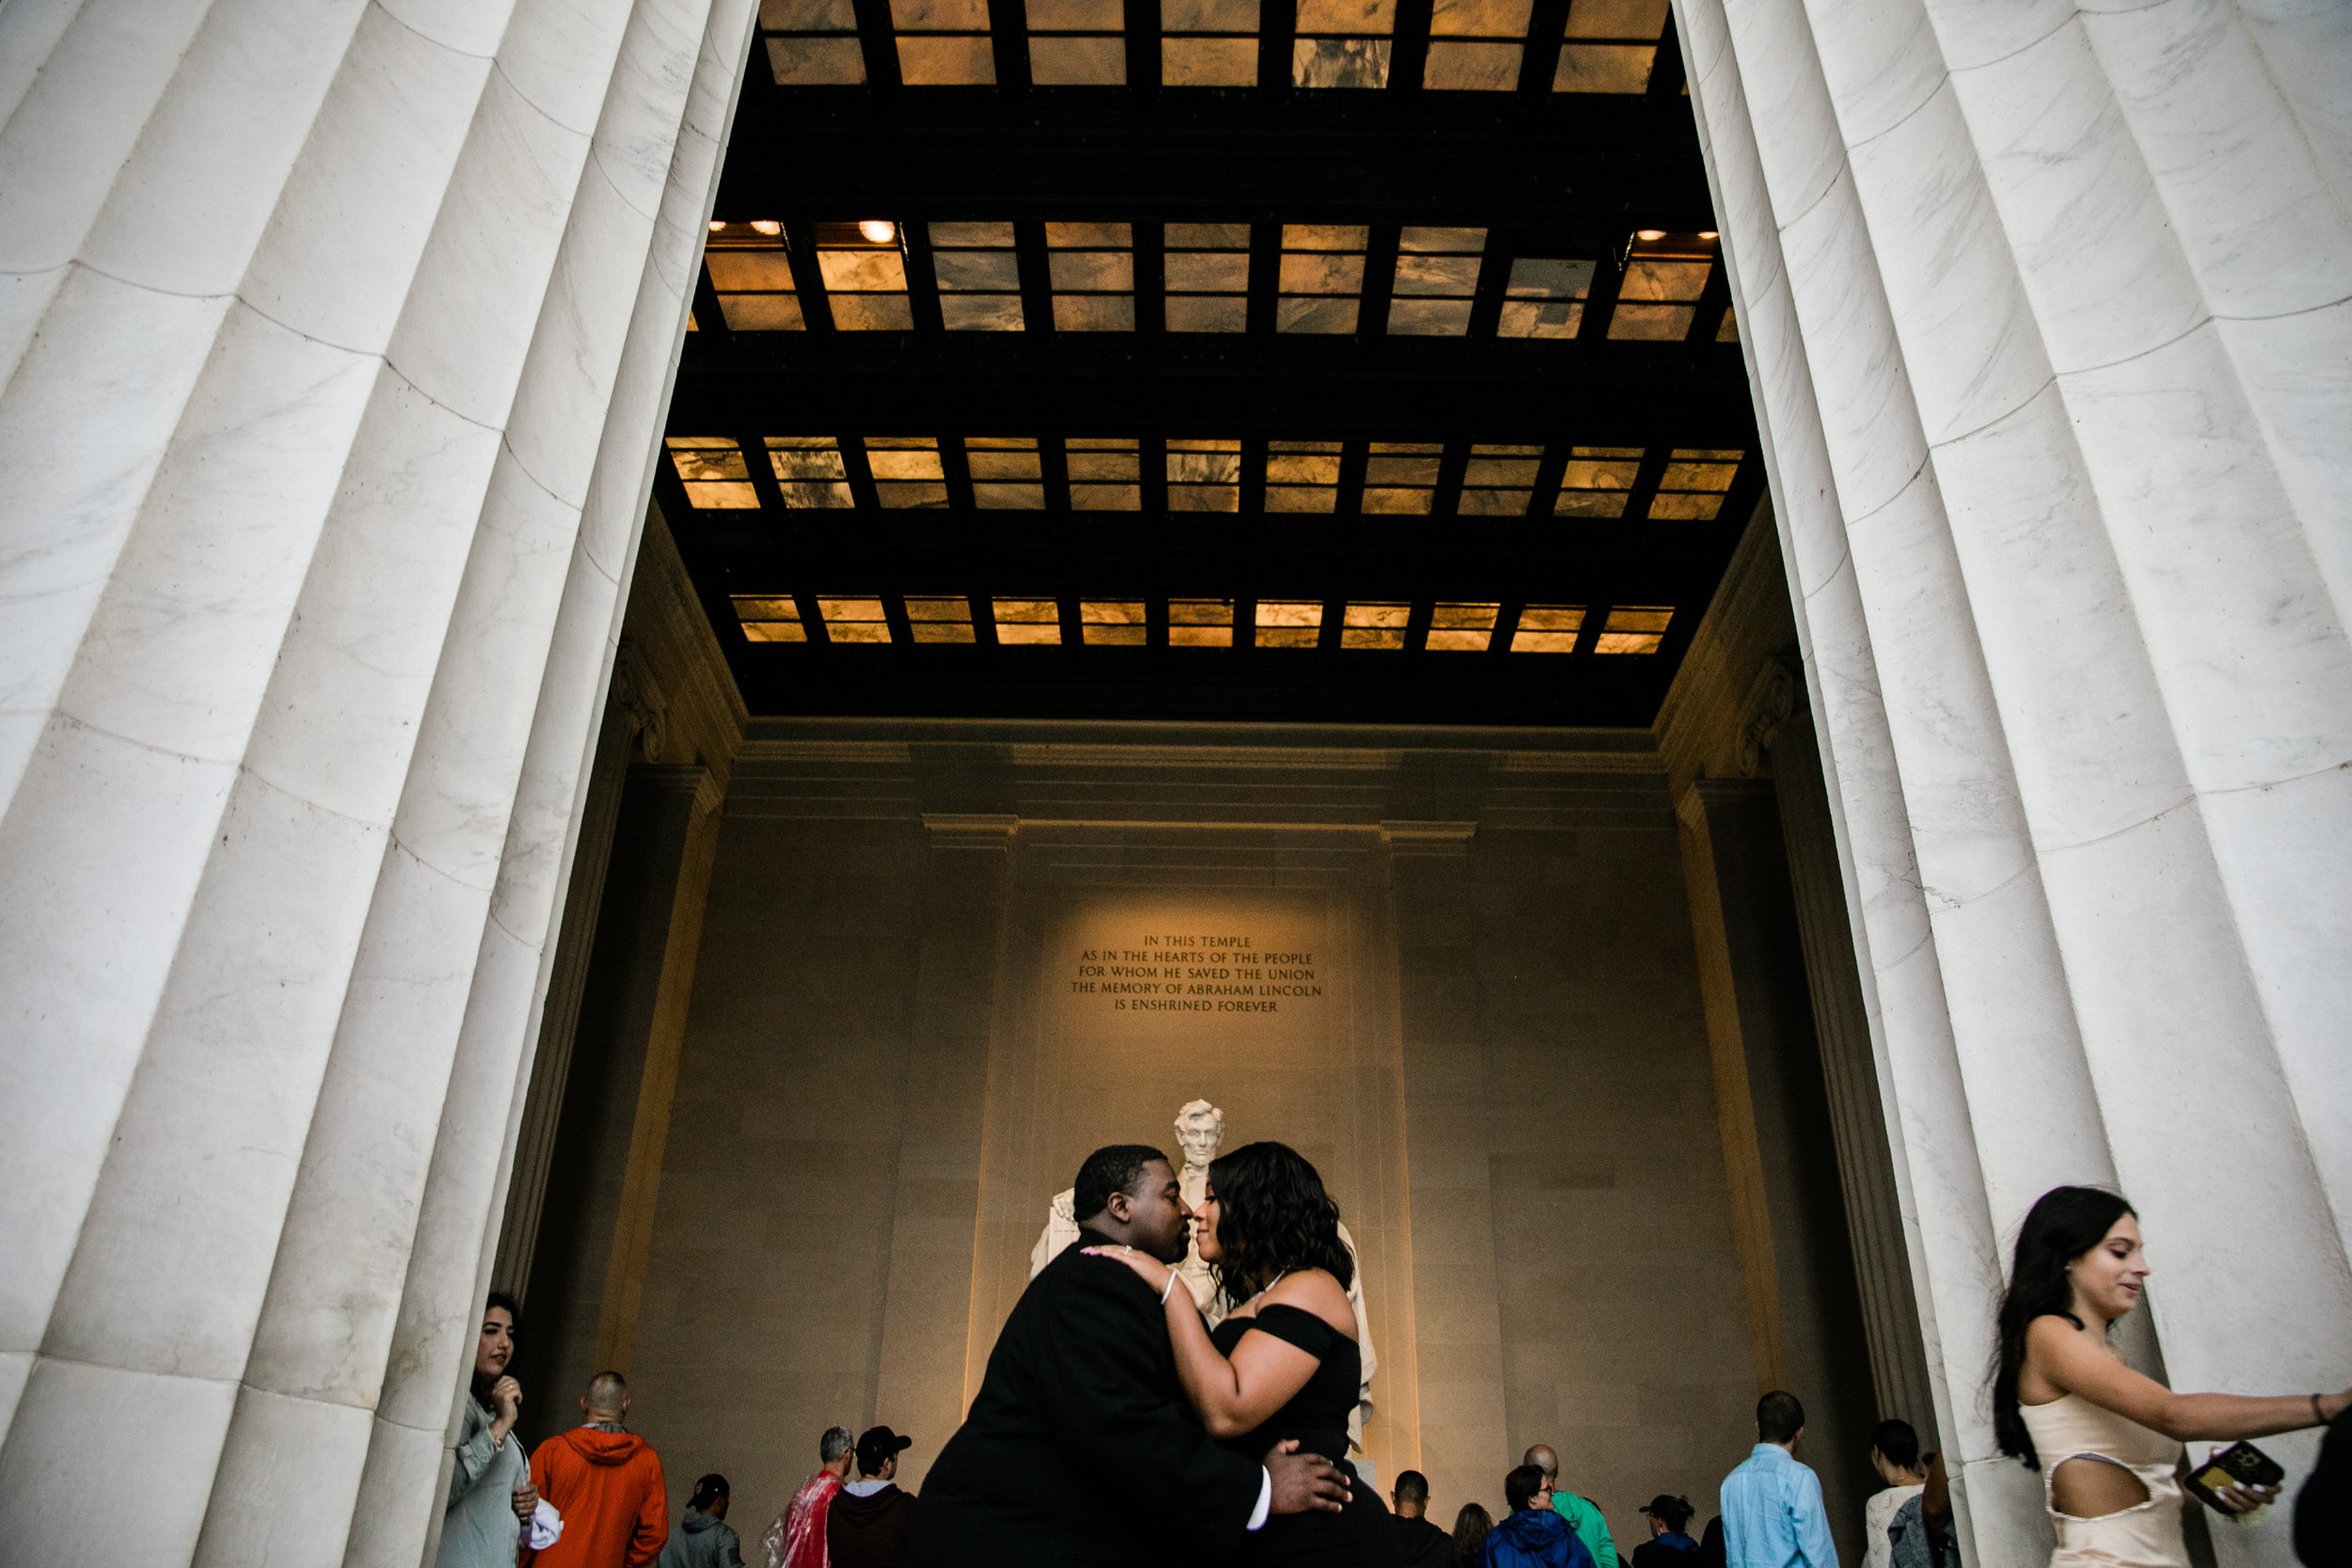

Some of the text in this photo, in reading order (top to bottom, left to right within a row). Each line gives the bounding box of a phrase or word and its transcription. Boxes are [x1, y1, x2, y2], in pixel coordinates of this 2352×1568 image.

[1145, 936, 1250, 947] IN THIS TEMPLE
[1082, 951, 1312, 964] AS IN THE HEARTS OF THE PEOPLE
[1079, 967, 1314, 980] FOR WHOM HE SAVED THE UNION
[1072, 982, 1322, 996] THE MEMORY OF ABRAHAM LINCOLN
[1115, 999, 1278, 1012] IS ENSHRINED FOREVER
